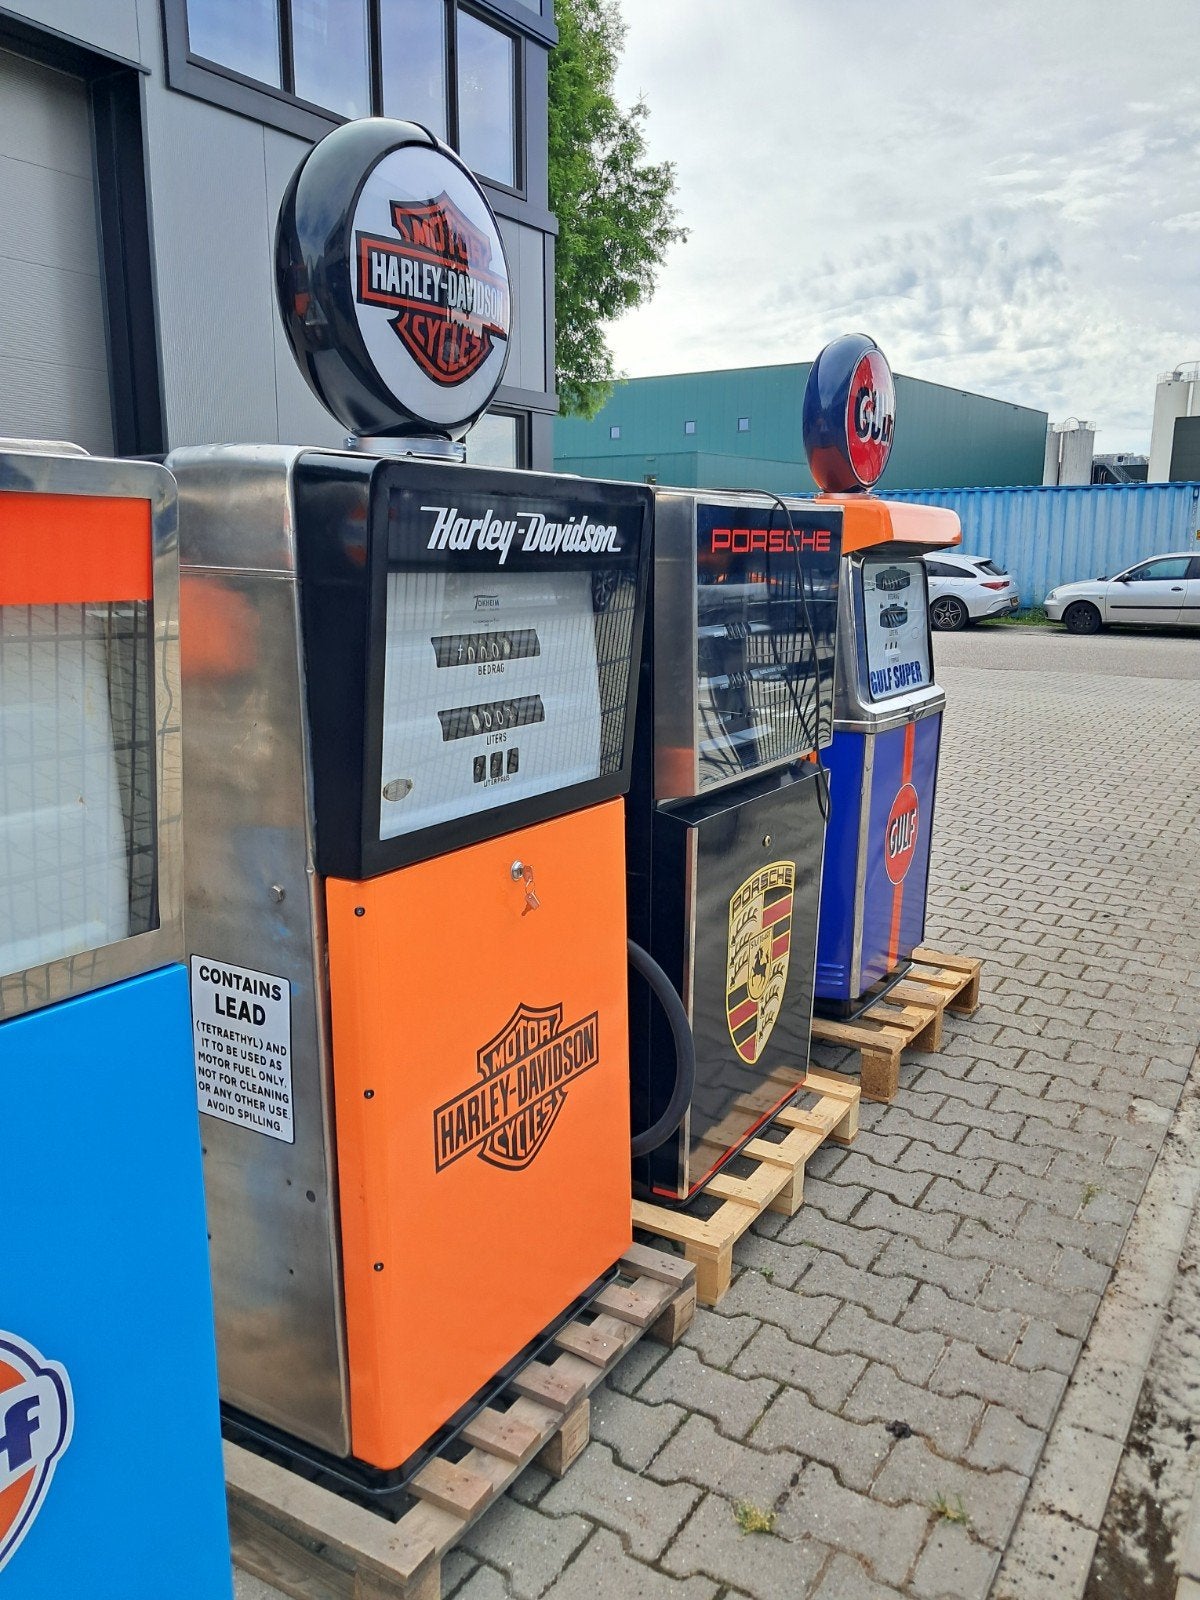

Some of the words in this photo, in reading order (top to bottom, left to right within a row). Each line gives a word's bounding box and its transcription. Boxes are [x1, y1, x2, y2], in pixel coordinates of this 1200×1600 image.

[372, 251, 504, 323] HARLEY-DAVIDSON
[412, 315, 482, 372] CYCLES
[420, 506, 621, 564] Harley-Davidson
[712, 529, 831, 553] PORSCHE
[478, 663, 505, 675] BEDRAG
[870, 667, 892, 695] GULF
[893, 661, 923, 689] SUPER
[487, 732, 507, 745] LITERS
[889, 808, 916, 859] GULF
[732, 867, 792, 916] PORSCHE
[199, 965, 282, 1001] CONTAINS
[215, 993, 266, 1026] LEAD
[196, 1020, 264, 1050] (TETRAETHYL)
[266, 1041, 287, 1056] AND
[201, 1038, 210, 1049] IT
[212, 1040, 224, 1053] TO
[226, 1044, 238, 1057] BE
[240, 1049, 267, 1066] USED
[269, 1058, 282, 1071] AS
[492, 1019, 551, 1074] MOTOR
[198, 1052, 230, 1070] MOTOR
[233, 1063, 256, 1078] FUEL
[198, 1066, 216, 1080] NOT
[219, 1074, 237, 1087] FOR
[239, 1080, 289, 1104] CLEANING
[198, 1081, 211, 1092] OR
[213, 1086, 232, 1100] ANY
[234, 1093, 266, 1112] OTHER
[268, 1104, 291, 1120] USE.
[440, 1022, 595, 1159] HARLEY-DAVIDSON
[207, 1098, 235, 1115] AVOID
[237, 1109, 284, 1132] SPILLING.
[493, 1094, 553, 1157] CYCLES
